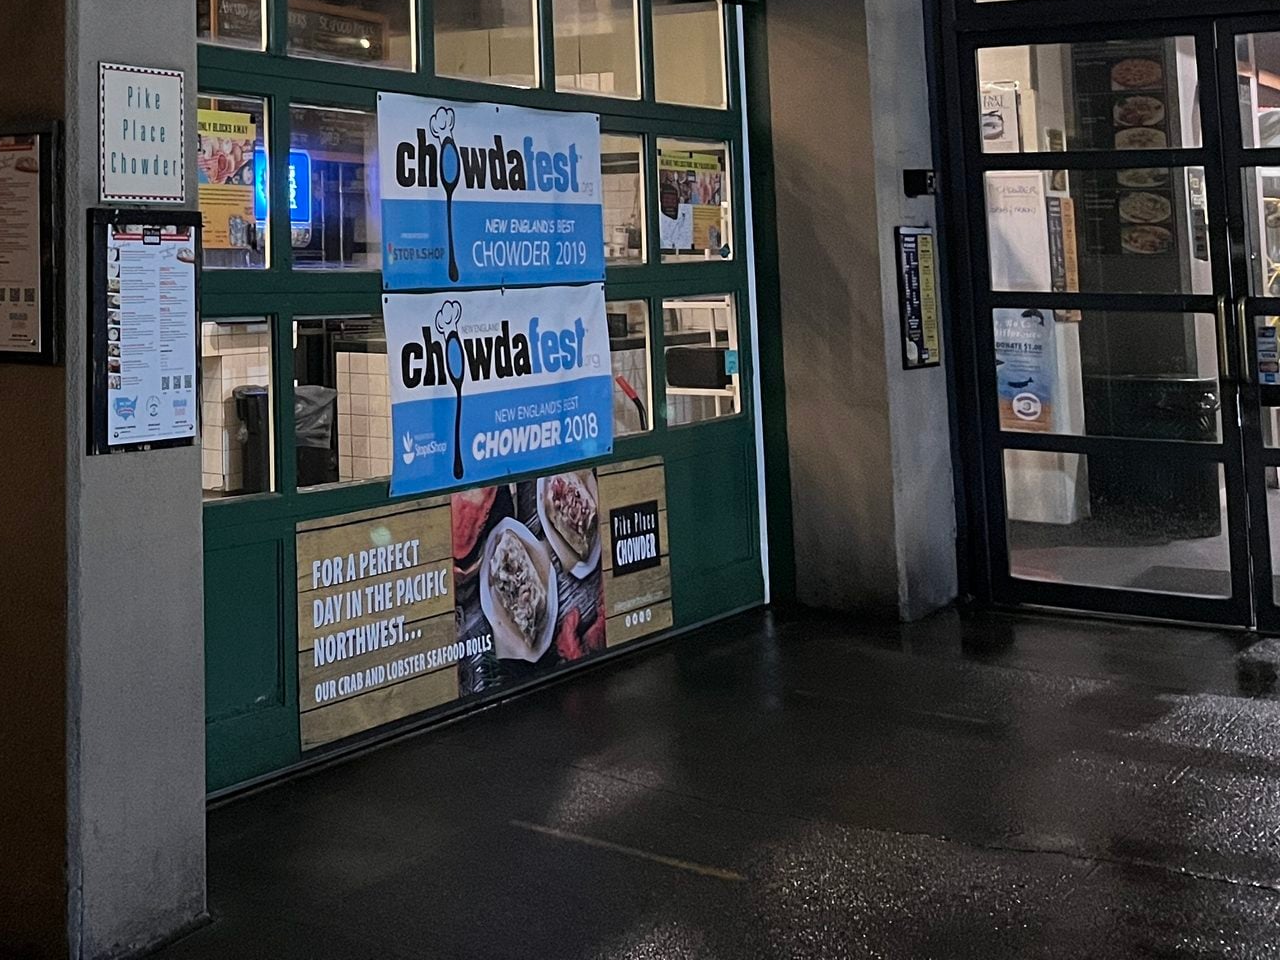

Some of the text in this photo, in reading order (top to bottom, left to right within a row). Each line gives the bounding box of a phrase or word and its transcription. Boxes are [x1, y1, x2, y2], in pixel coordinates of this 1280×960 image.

[128, 86, 160, 109] Pike
[123, 119, 165, 142] Place
[111, 152, 176, 176] Chowder
[396, 128, 580, 193] chowdafest
[485, 219, 575, 234] NEW ENGLAND'S BEST
[472, 241, 586, 267] CHOWDER 2019
[401, 316, 586, 389] chowdafest
[495, 396, 579, 423] NEW ENGLAND'S BEST
[472, 412, 598, 461] CHOWDER 2018
[614, 512, 655, 537] Pike Place
[312, 539, 419, 590] FOR A PERFECT
[616, 532, 657, 566] CHOWDER
[313, 568, 448, 629] DAY IN THE PACIFIC
[313, 615, 422, 668] NORTHWEST...
[315, 633, 492, 702] OUR CRAB AND LOBSTER SEAFOOD ROLLS
